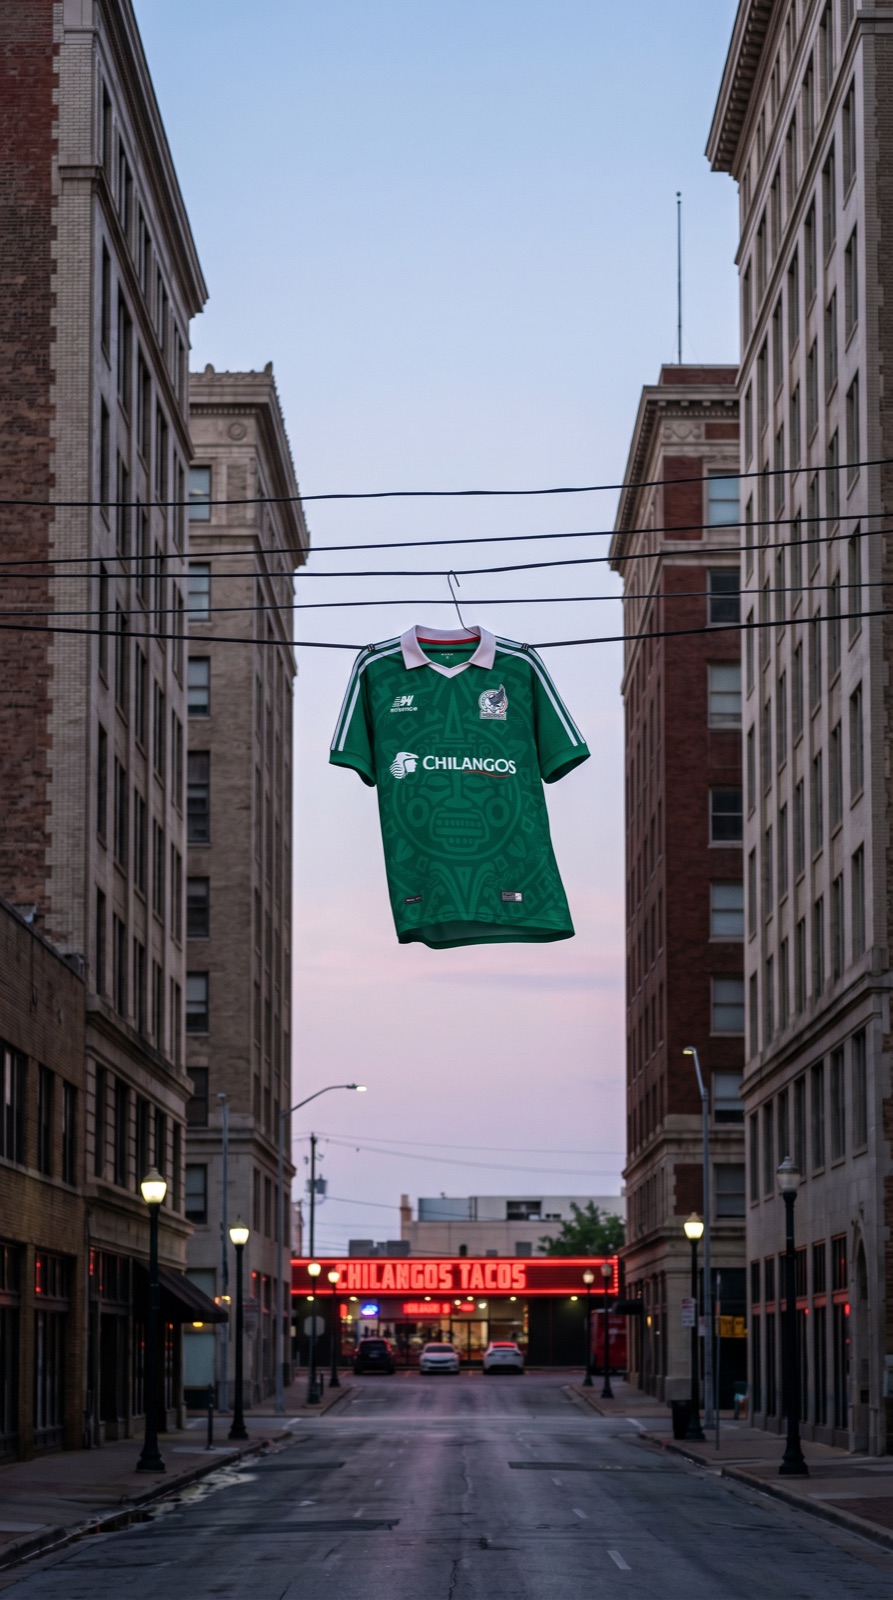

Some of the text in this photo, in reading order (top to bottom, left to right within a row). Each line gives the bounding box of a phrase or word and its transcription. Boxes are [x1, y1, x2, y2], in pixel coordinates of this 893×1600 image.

[422, 755, 517, 775] CHILANGOS
[335, 1263, 526, 1289] CHILANGOS TACOS
